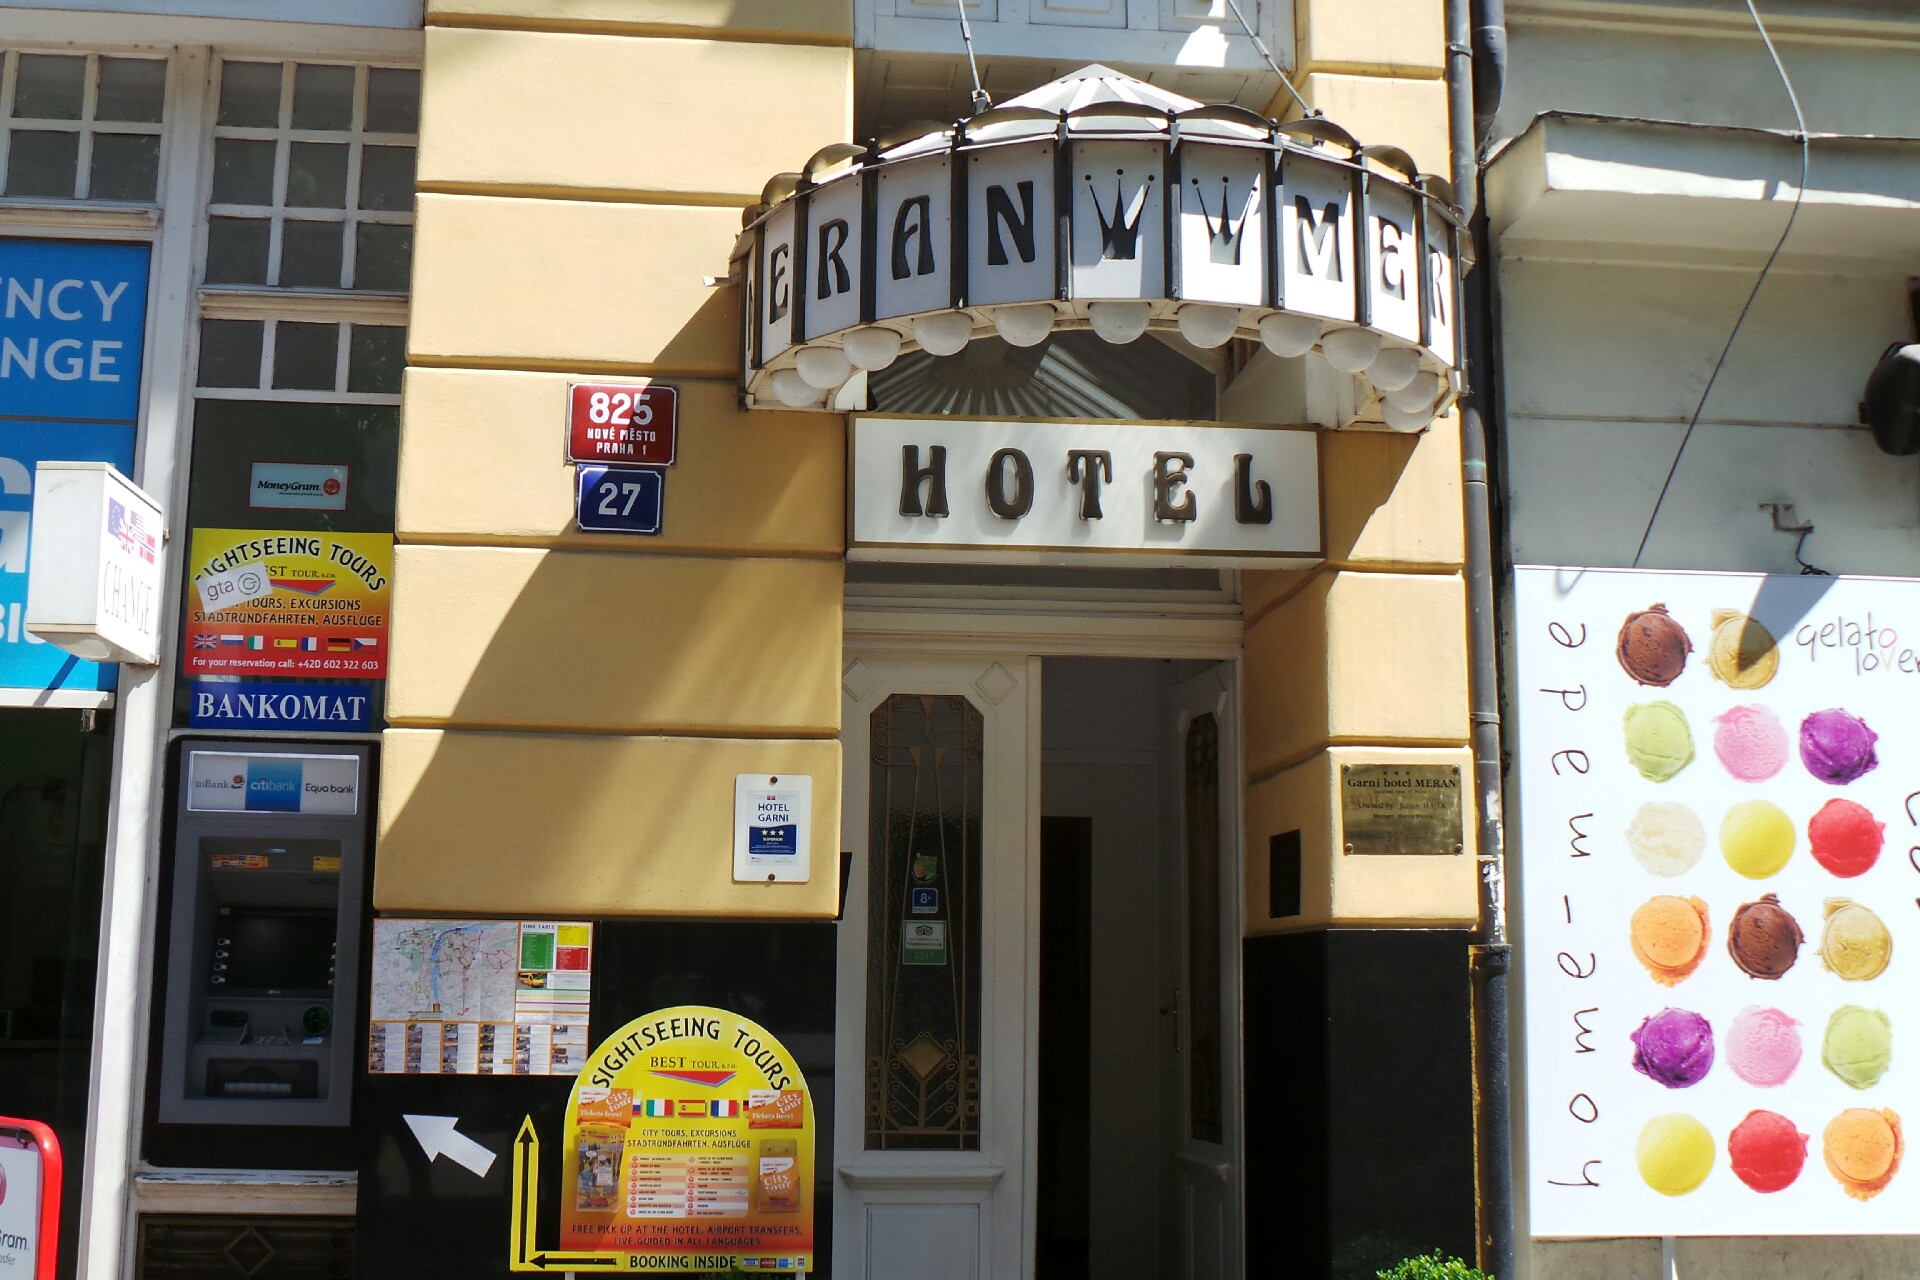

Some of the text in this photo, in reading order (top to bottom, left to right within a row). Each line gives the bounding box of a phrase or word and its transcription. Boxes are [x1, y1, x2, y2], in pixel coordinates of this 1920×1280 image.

[749, 180, 1036, 353] ERAN
[0, 277, 129, 322] NCY
[0, 336, 123, 382] NGE
[589, 392, 653, 426] 825
[587, 426, 656, 442] NOVÉ MĚSTO
[597, 442, 647, 456] PRAHA 1
[257, 480, 320, 491] MoneyGram
[898, 444, 1273, 525] HOTEL
[598, 482, 641, 516] 27
[330, 544, 386, 591] TOURS
[103, 560, 152, 635] CHANGE
[207, 580, 234, 601] gta
[290, 598, 361, 611] EXCURSIONS
[322, 614, 382, 627] AUSFLÜGE
[1797, 612, 1897, 662] gelato
[193, 659, 379, 670] For your reservation call: +420 602 322 603
[196, 692, 366, 721] BANKOMAT
[195, 780, 229, 789] mBank
[250, 779, 295, 792] citibank
[305, 783, 354, 793] Equa bank
[1347, 778, 1456, 788] Garni hotel MERAN
[758, 803, 789, 812] HOTEL
[758, 814, 789, 822] GARNI
[1540, 621, 1602, 1187] home-made
[592, 1017, 720, 1088] SIGHTSEEING
[733, 1029, 790, 1090] TOURS
[650, 1056, 687, 1068] BEST
[606, 1090, 627, 1105] City
[608, 1097, 631, 1112] tour
[776, 1092, 797, 1107] City
[580, 1109, 604, 1117] Tickets
[779, 1098, 801, 1114] tour
[690, 1130, 737, 1138] EXCURSIONS
[711, 1139, 751, 1148] AUSFLÜGE
[763, 1174, 789, 1186] City
[572, 1225, 593, 1233] FREE
[597, 1225, 616, 1233] PICK
[620, 1225, 632, 1234] UP
[636, 1226, 646, 1234] AT
[651, 1226, 668, 1234] THE
[707, 1226, 744, 1235] AIRPORT
[613, 1237, 633, 1245] LIVE
[637, 1237, 670, 1246] GUIDED
[687, 1238, 702, 1246] ALL
[706, 1238, 761, 1246] LANGUAGES
[629, 1255, 689, 1268] BOOKING
[693, 1255, 737, 1269] INSIDE
